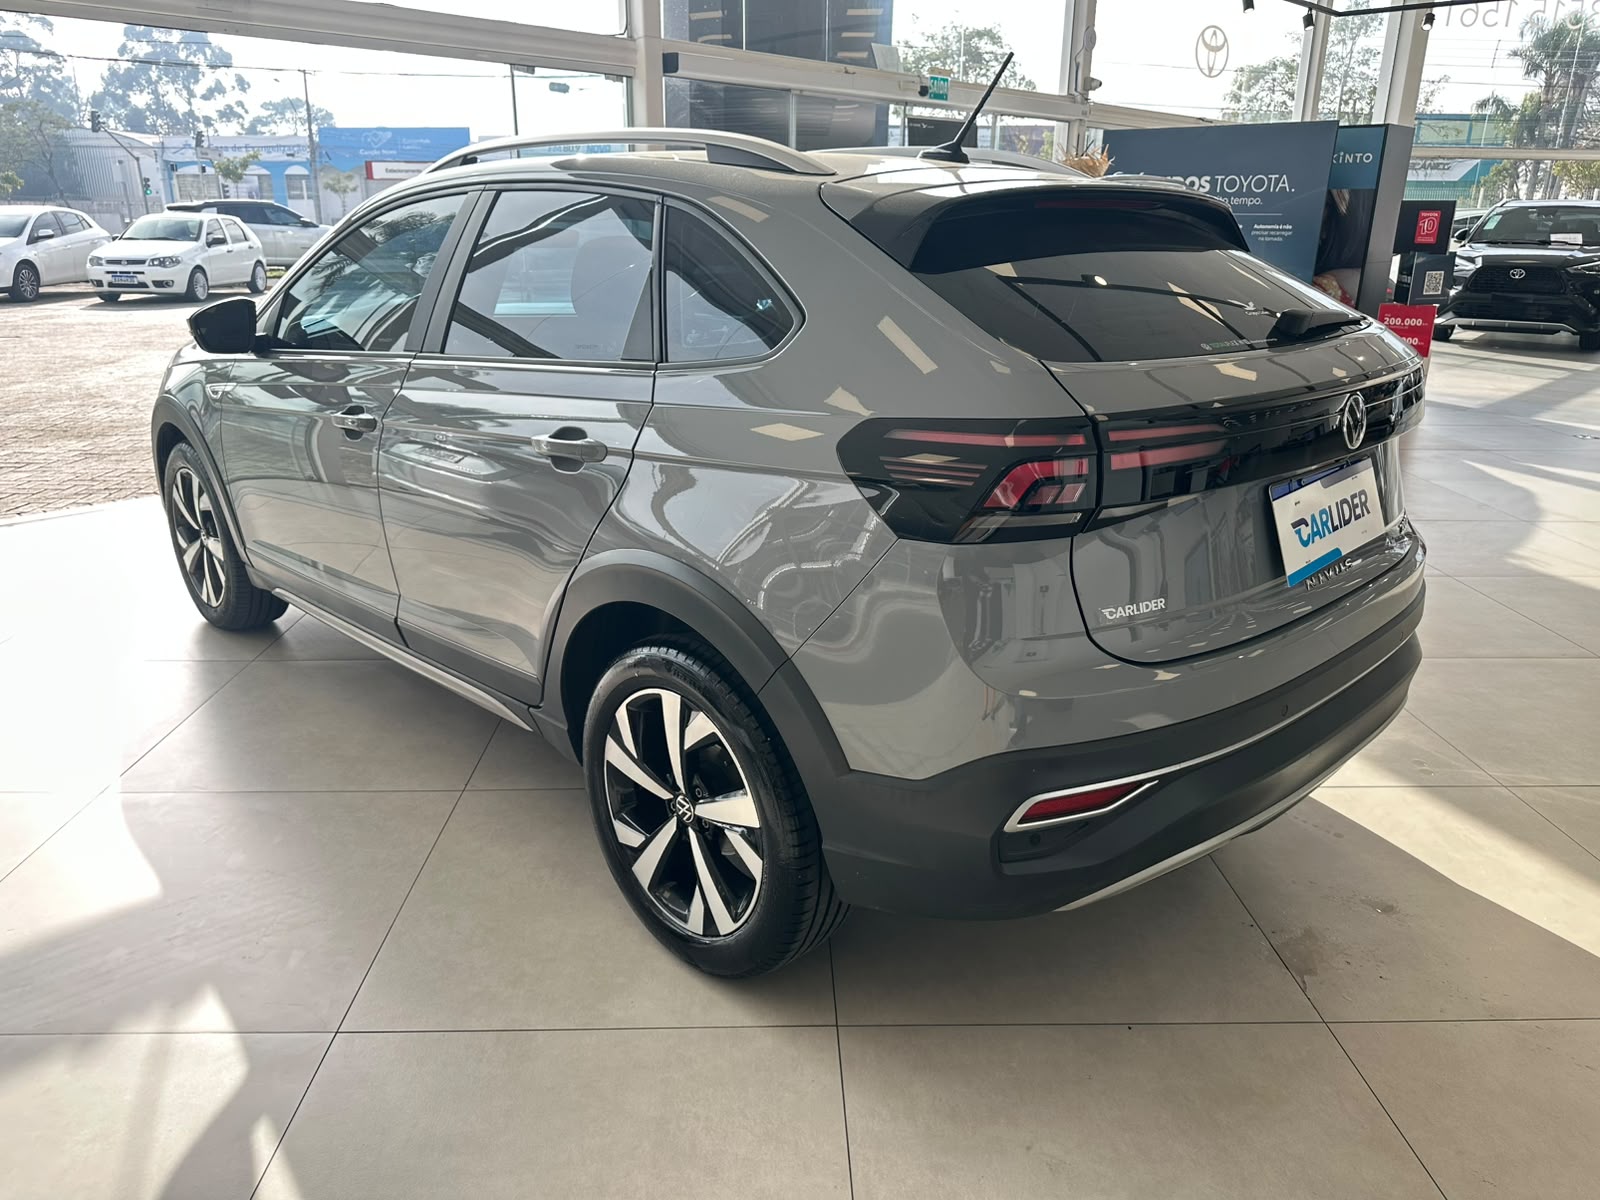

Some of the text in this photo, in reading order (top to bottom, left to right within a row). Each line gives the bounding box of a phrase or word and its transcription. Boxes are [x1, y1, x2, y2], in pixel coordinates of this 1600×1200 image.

[1214, 174, 1295, 193] TOYOTA.
[1230, 195, 1263, 207] tempo.
[1419, 217, 1437, 235] 10
[1384, 317, 1423, 327] 200.000
[1290, 489, 1371, 548] CARLIDER
[1101, 597, 1166, 619] CARLIDER
